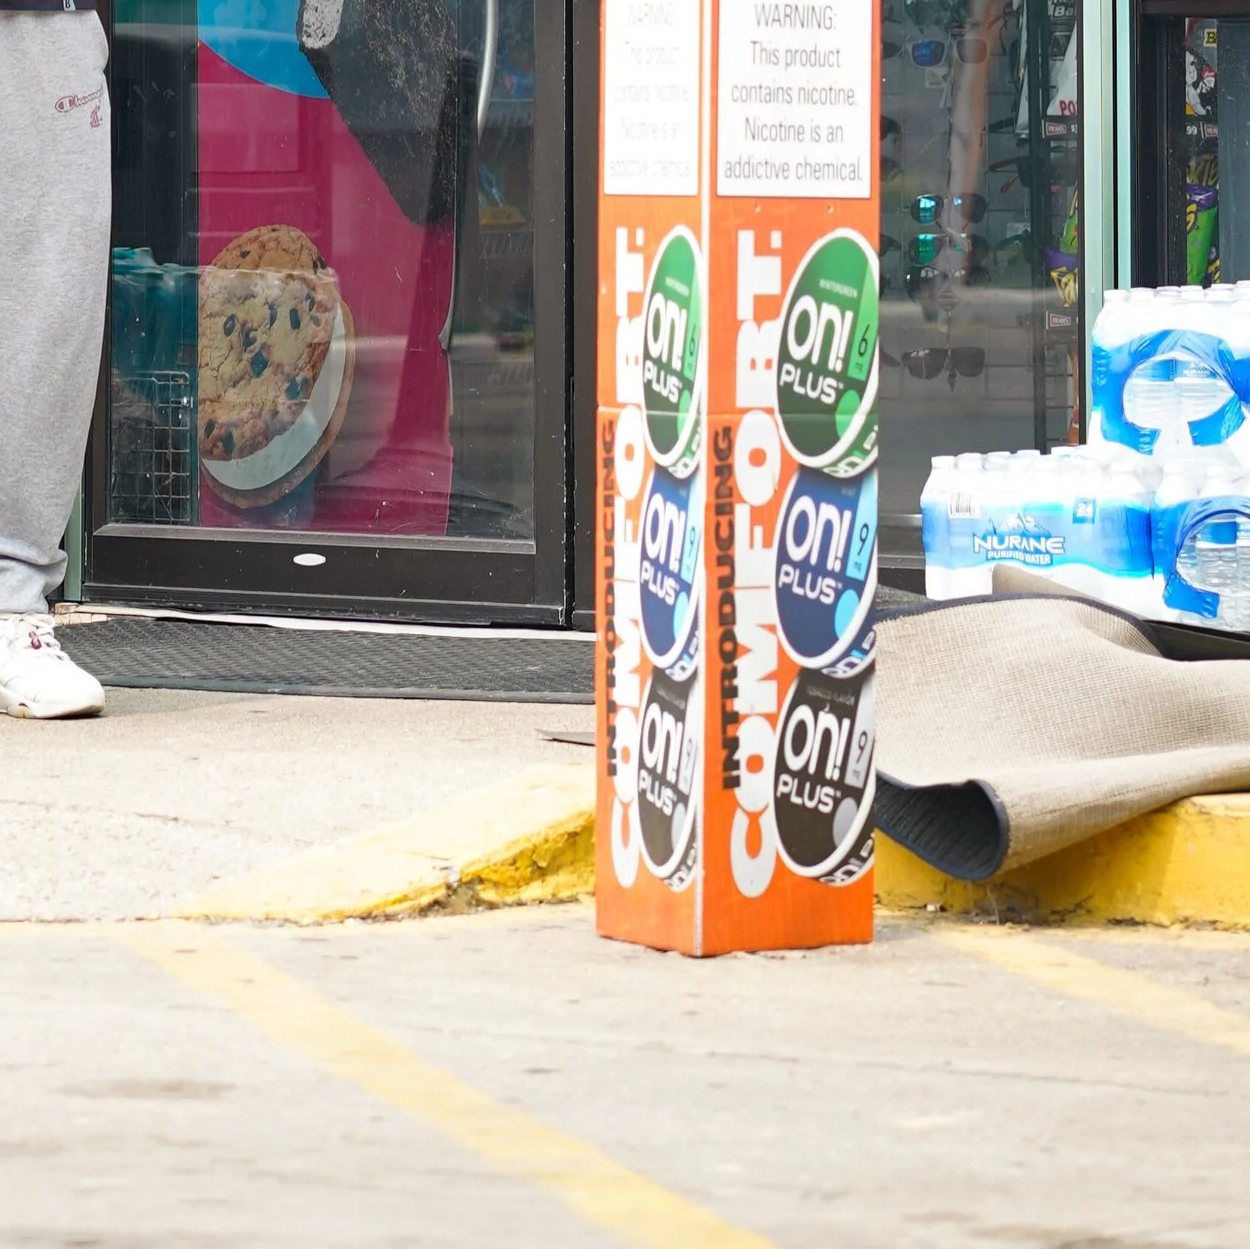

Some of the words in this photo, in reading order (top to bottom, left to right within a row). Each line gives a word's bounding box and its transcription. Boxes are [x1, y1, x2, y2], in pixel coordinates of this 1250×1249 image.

[755, 3, 837, 30] WARNING:
[750, 40, 780, 66] This
[785, 43, 841, 71] product
[731, 80, 793, 105] contains
[798, 81, 858, 106] nicotine.
[744, 116, 805, 142] Nicotine
[810, 121, 822, 143] is
[826, 126, 844, 143] an
[724, 154, 790, 180] addictive
[796, 155, 863, 181] chemical.
[689, 324, 696, 357] 6
[858, 324, 869, 357] 6
[643, 357, 680, 404] PLUS
[779, 363, 837, 404] PLUS
[1076, 503, 1093, 517] 24
[689, 526, 696, 557] 9
[858, 523, 869, 557] 9
[973, 532, 1065, 554] NURANE
[987, 549, 1024, 562] PURIFIED
[1024, 553, 1052, 566] WATER
[640, 560, 677, 606] PLUS
[778, 564, 836, 605] PLUS
[714, 425, 740, 791] INTRODUCING
[857, 730, 868, 764] 9
[638, 768, 675, 816] PLUS
[776, 773, 835, 814] PLUS
